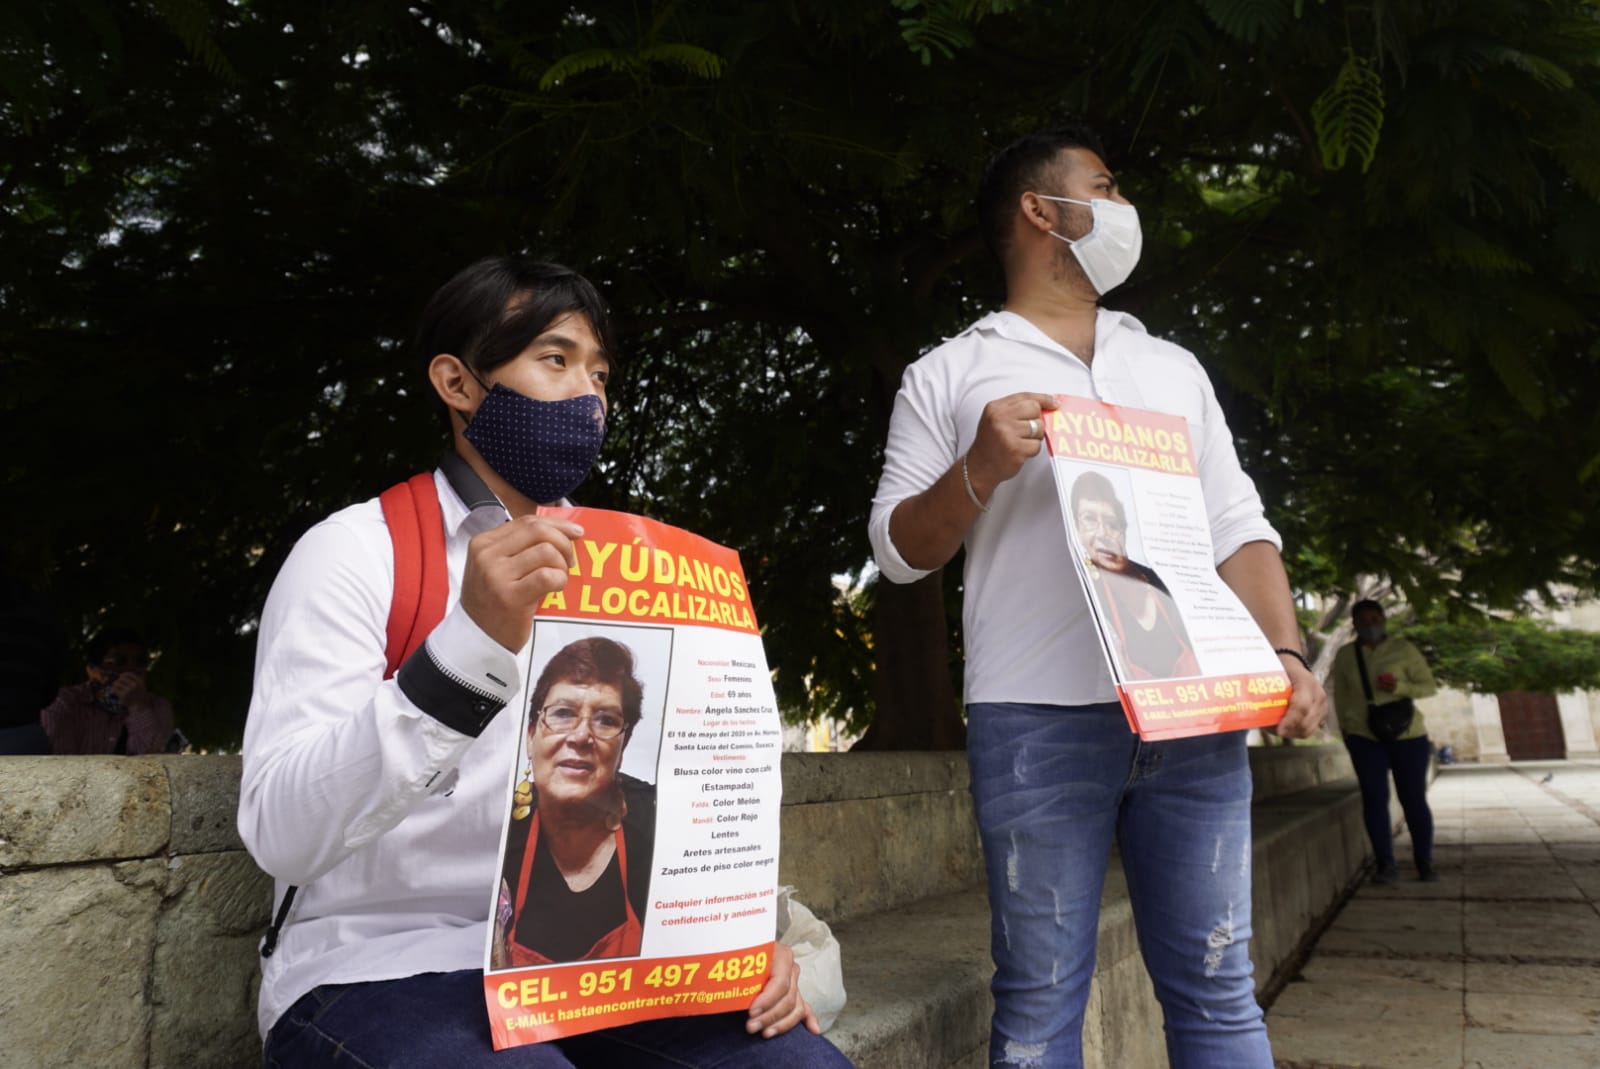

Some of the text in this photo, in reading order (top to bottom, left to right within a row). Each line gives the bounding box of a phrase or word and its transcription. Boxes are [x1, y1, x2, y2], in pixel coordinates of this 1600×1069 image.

[1052, 410, 1187, 454] AYÚDANOS
[1058, 437, 1193, 474] A LOCALIZARLA
[541, 585, 755, 629] A LOCALIZARLA
[727, 690, 736, 698] 69
[737, 690, 752, 698] años
[1133, 676, 1286, 707] CEL. 951 497 4829
[667, 730, 675, 738] El
[698, 731, 718, 739] mayo
[674, 743, 695, 751] Santa
[673, 767, 699, 776] Blusa
[701, 767, 723, 775] color
[725, 766, 743, 774] vino
[745, 766, 759, 774] con
[701, 782, 754, 793] (Estampada)
[712, 799, 735, 807] Color
[716, 814, 739, 823] Color
[740, 813, 758, 822] Rojo
[711, 831, 740, 839] Lentes
[682, 844, 762, 858] Aretes artesanales
[661, 857, 775, 877] Zapatos de piso color negro
[655, 900, 702, 910] Cualquier
[705, 892, 757, 905] información
[661, 914, 722, 927] confidencial
[723, 914, 730, 923] y
[497, 952, 768, 1009] CEL. 951 497 4829
[505, 1011, 555, 1031] E-MAIL:
